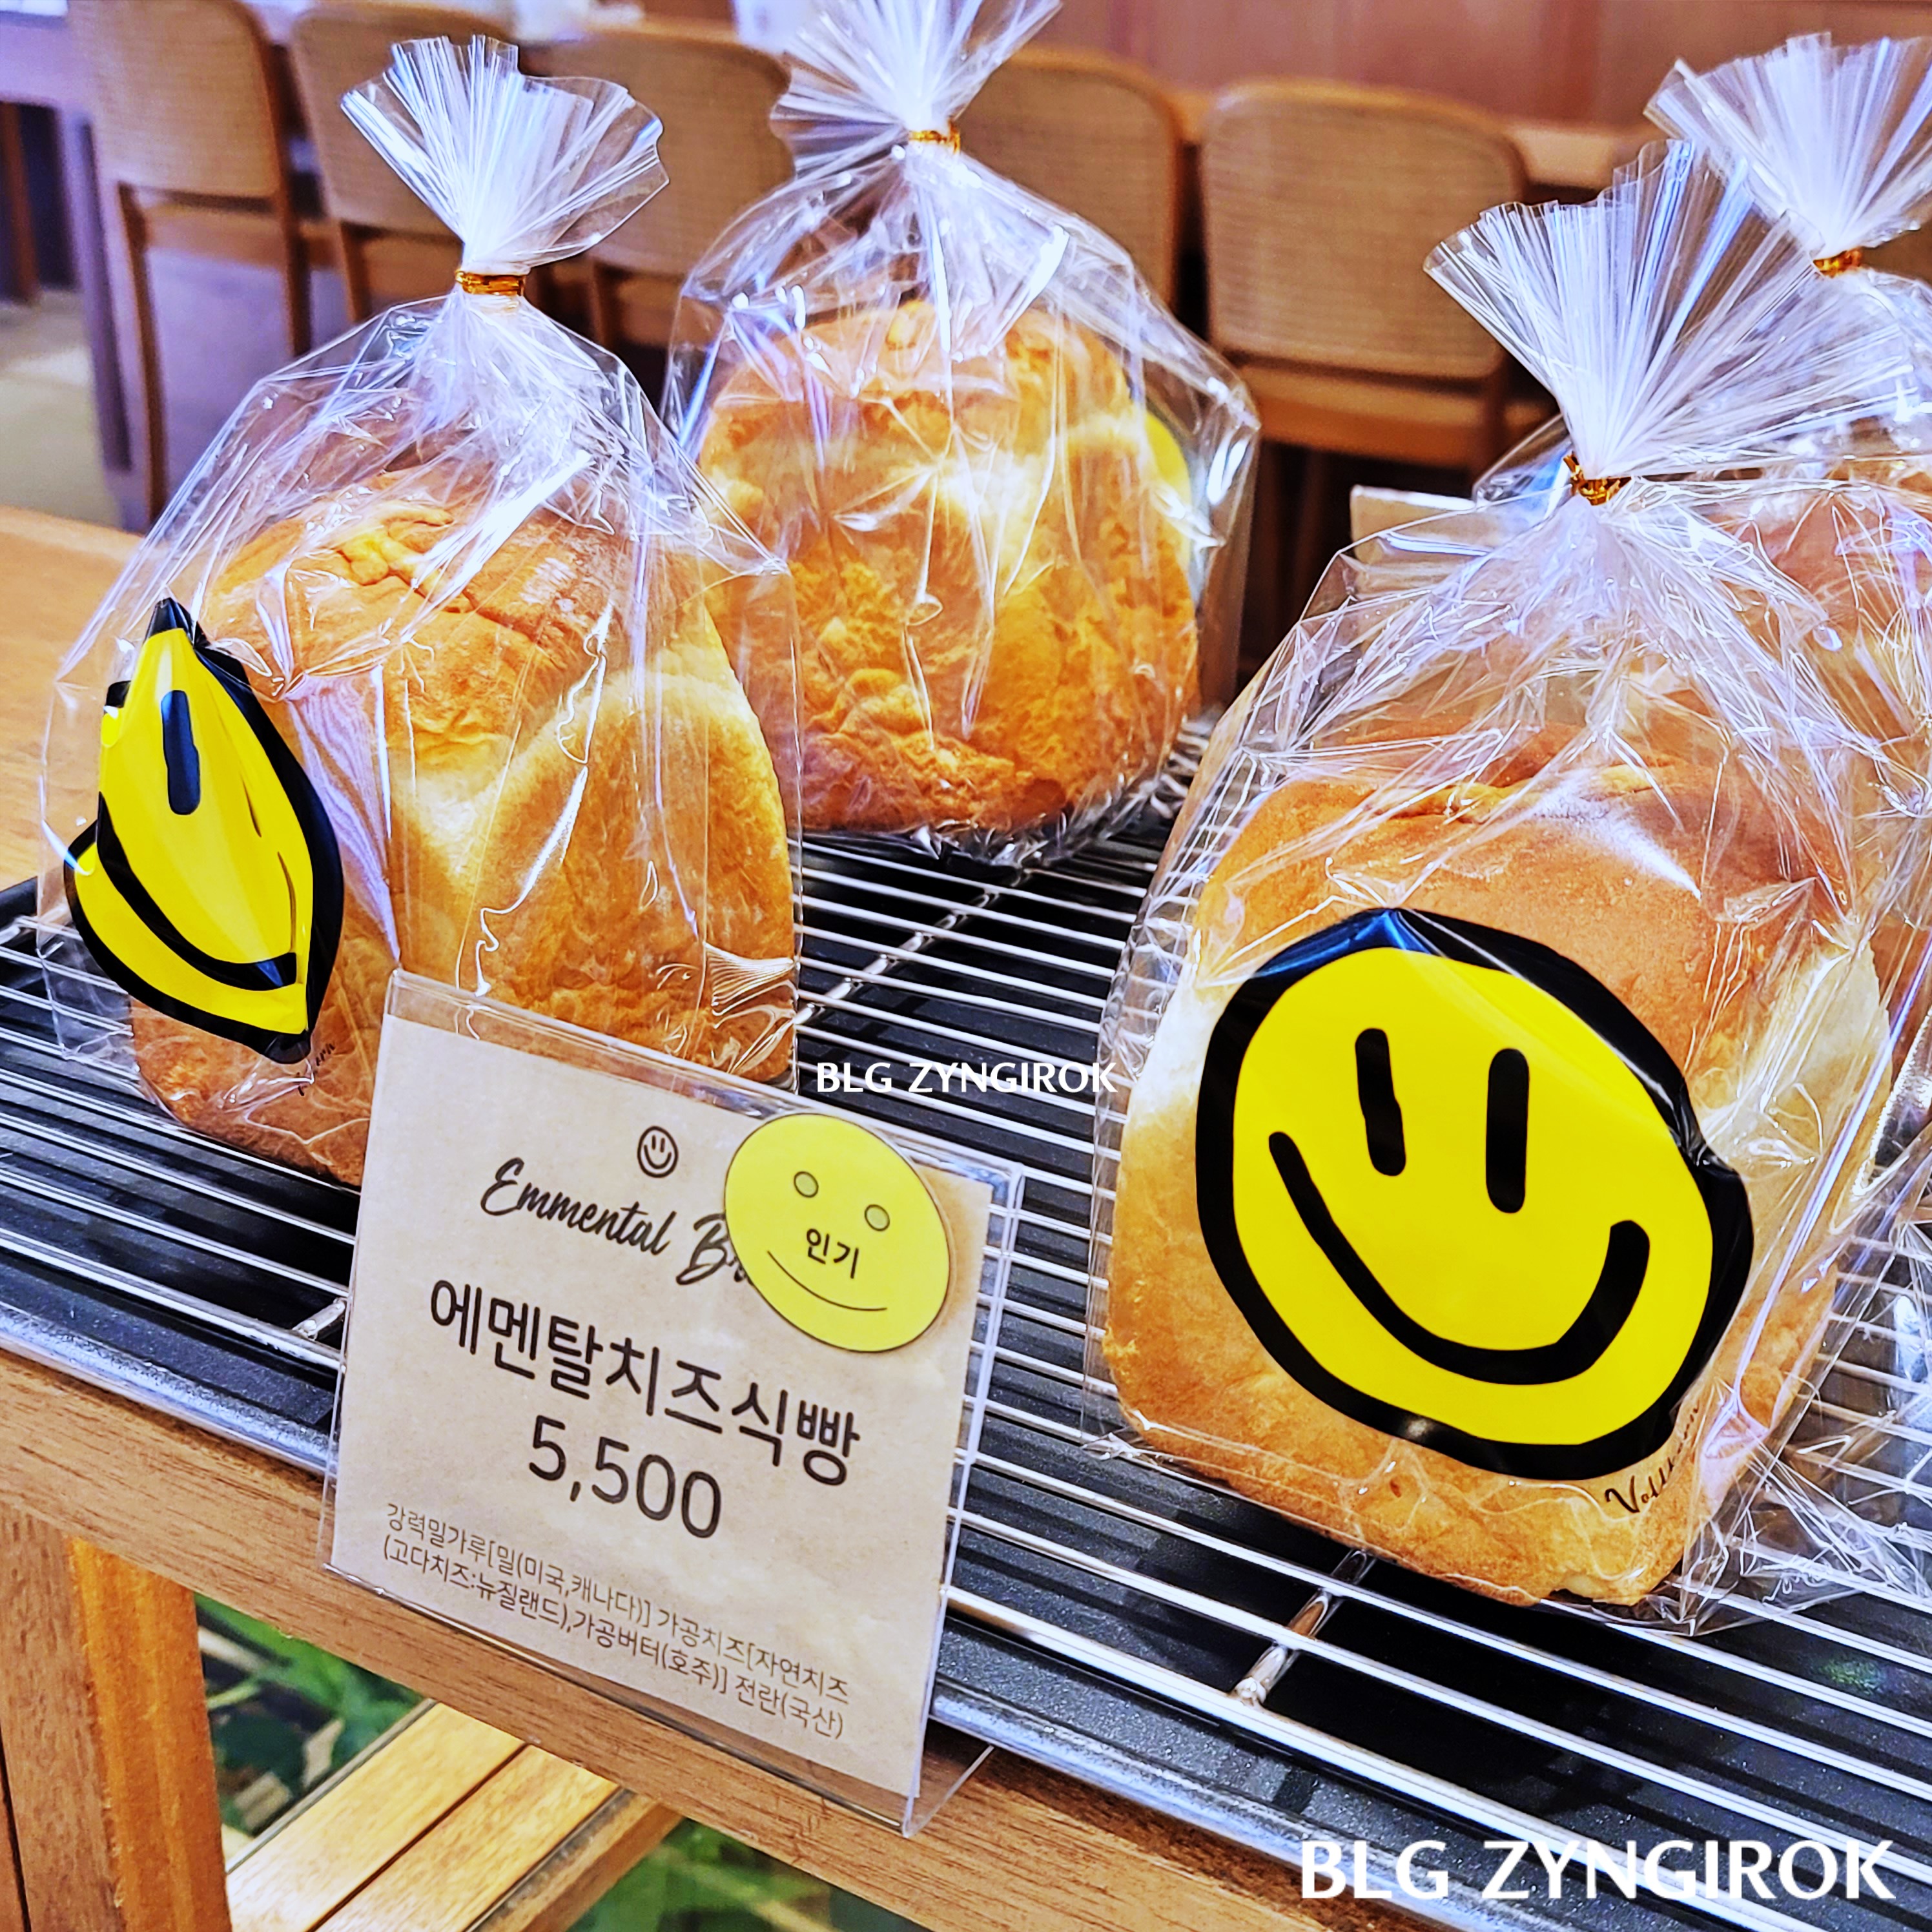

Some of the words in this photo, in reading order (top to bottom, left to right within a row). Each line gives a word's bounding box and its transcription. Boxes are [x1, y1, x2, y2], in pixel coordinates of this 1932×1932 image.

[480, 1157, 676, 1257] Emmental
[805, 1228, 861, 1280] 인기
[430, 1279, 861, 1486] 에멘탈치즈식빵
[528, 1415, 723, 1540] 5,500
[657, 1608, 850, 1705] 가공치즈[자연치즈
[734, 1675, 844, 1740] 전란(국산)
